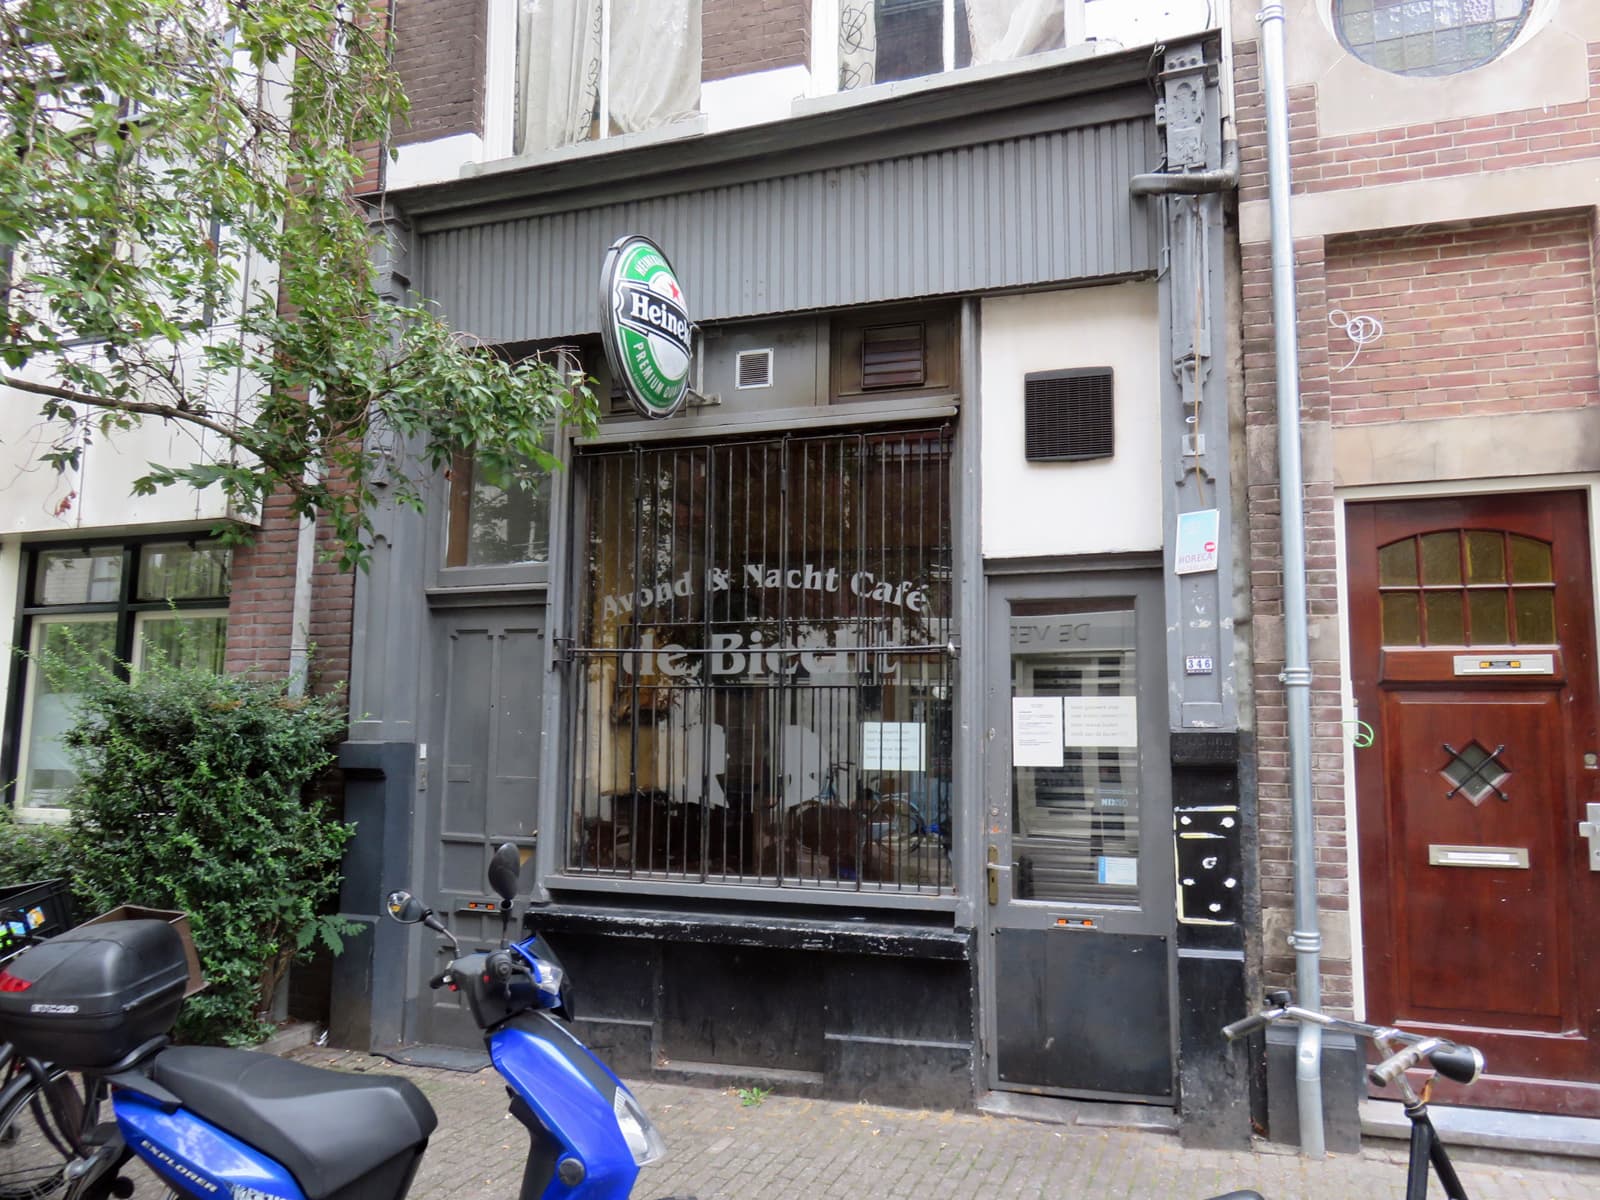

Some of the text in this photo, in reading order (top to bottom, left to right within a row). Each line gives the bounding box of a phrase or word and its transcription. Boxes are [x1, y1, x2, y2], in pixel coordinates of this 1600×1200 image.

[633, 341, 665, 395] PREMIUM
[1179, 552, 1213, 564] HORECA
[602, 563, 930, 621] Avond & Nacht Café
[622, 630, 688, 677] de
[1188, 659, 1211, 669] 346
[141, 1140, 218, 1193] EXPLORER
